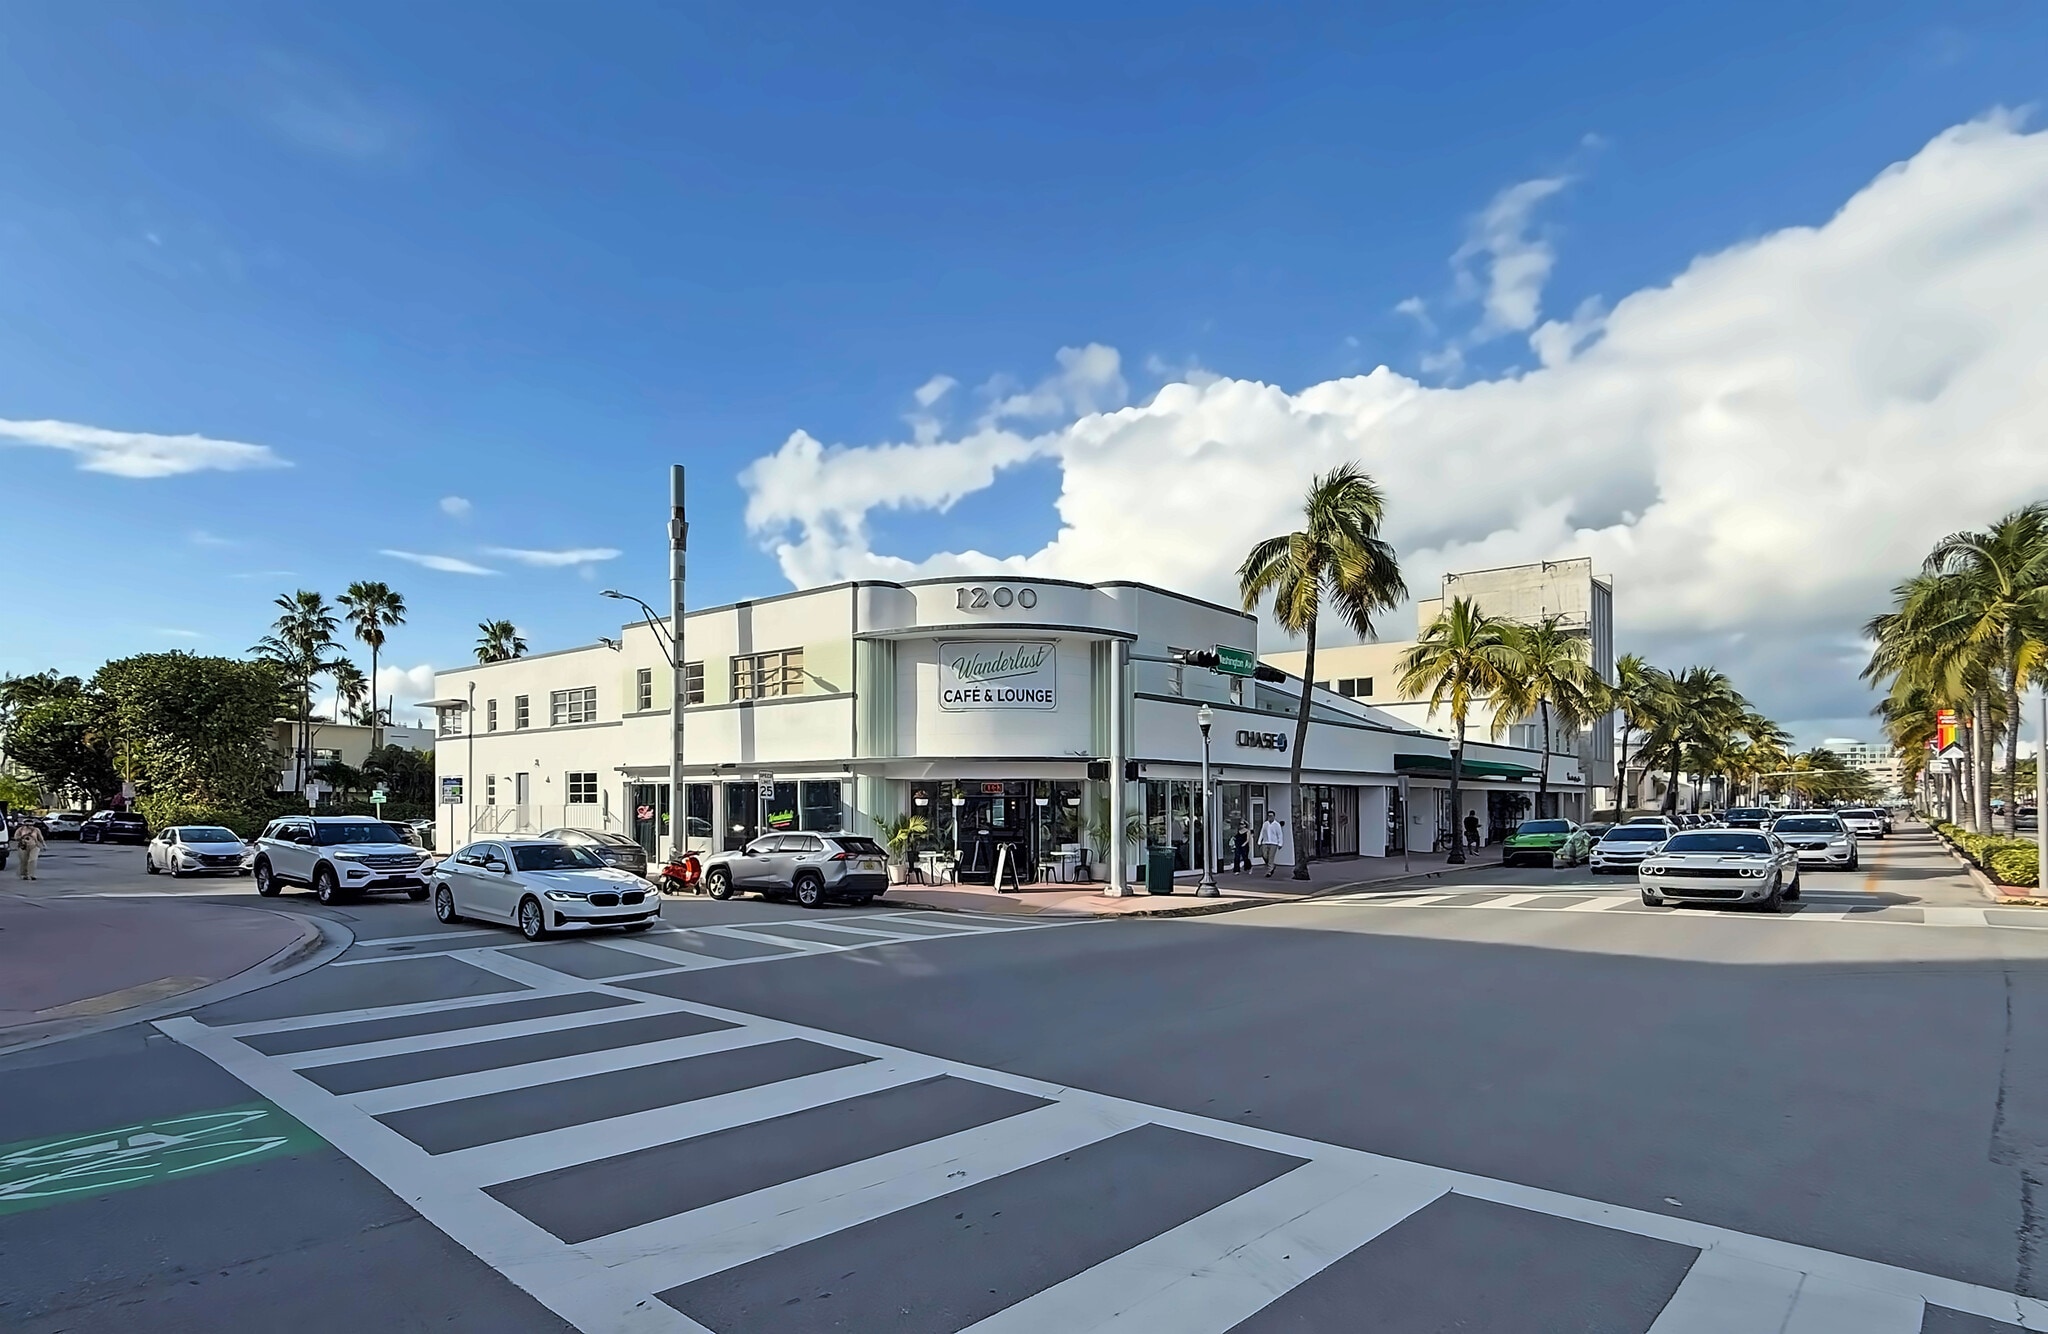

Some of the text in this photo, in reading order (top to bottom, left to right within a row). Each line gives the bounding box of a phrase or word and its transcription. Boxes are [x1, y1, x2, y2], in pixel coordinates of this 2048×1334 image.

[956, 586, 1038, 609] 1200
[952, 645, 1044, 680] Wanderlust
[944, 686, 1053, 703] CAFÉ & LOUNGE
[1235, 730, 1279, 749] CHASE
[760, 786, 773, 797] 25
